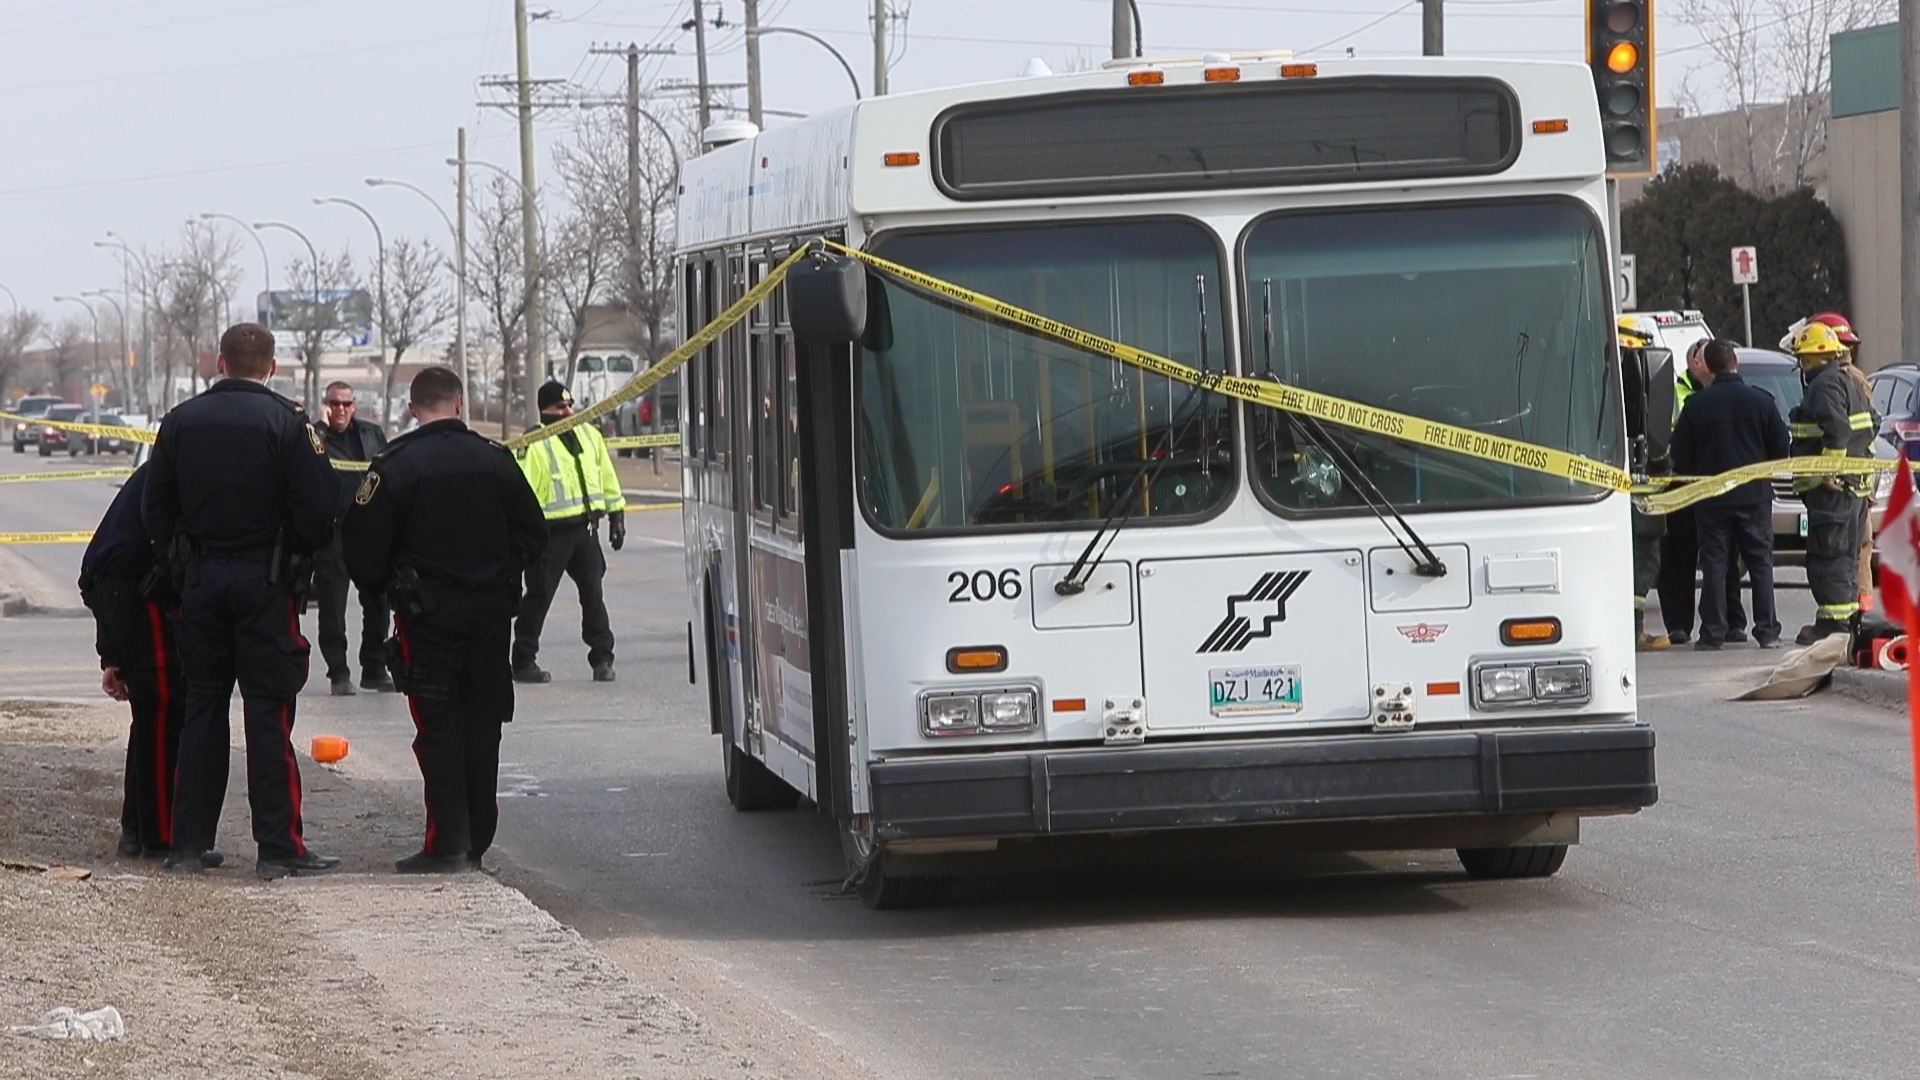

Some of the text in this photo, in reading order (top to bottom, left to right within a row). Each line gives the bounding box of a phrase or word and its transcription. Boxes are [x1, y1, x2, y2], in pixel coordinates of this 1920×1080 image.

[1225, 378, 1261, 398] CROSS
[1281, 389, 1405, 435] FIRE LINE DO NOT CROSS
[1424, 424, 1548, 469] FIRE LINE DO NOT CROSS
[1567, 458, 1589, 480] FIRE
[1590, 464, 1609, 485] LINE
[1612, 471, 1622, 487] DO
[947, 568, 1022, 603] 206
[1214, 677, 1294, 703] DZJ 421
